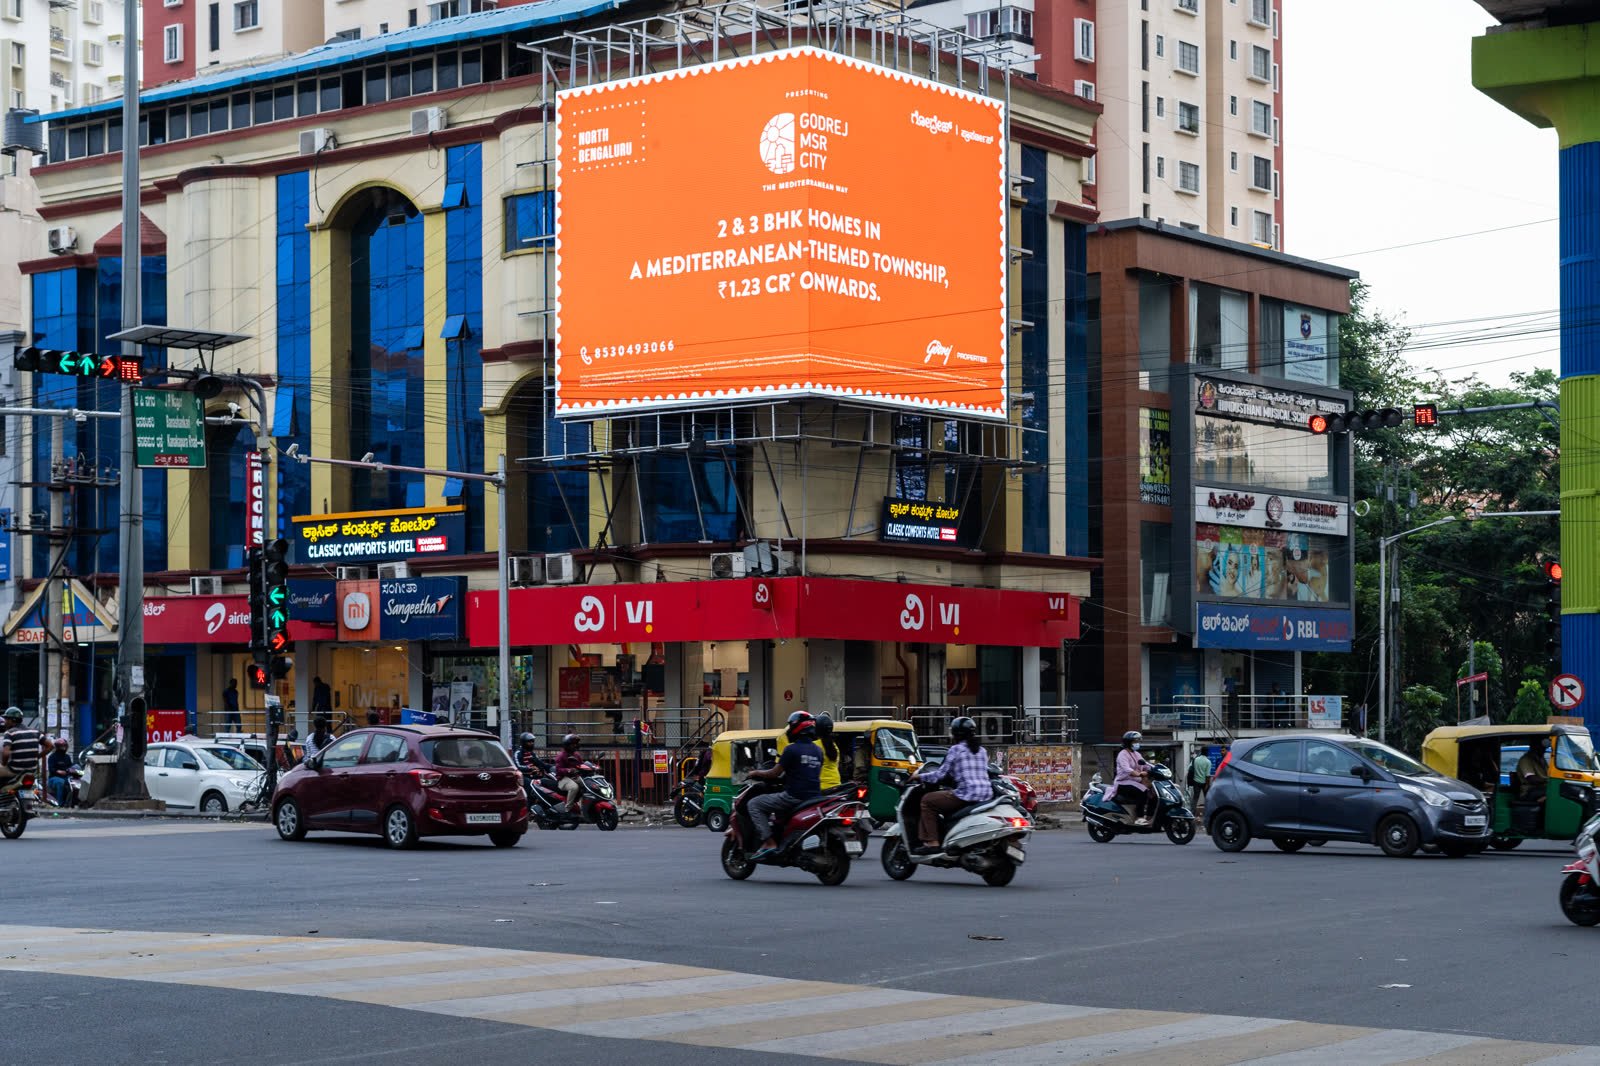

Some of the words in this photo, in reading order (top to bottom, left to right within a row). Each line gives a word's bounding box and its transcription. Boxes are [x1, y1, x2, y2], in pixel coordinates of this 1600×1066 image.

[785, 88, 828, 100] PRESENTING
[799, 112, 848, 137] GODREJ
[578, 128, 609, 146] NORTH
[800, 132, 828, 151] MSR
[578, 142, 632, 164] BENGALURU
[799, 152, 827, 170] CITY
[762, 184, 776, 192] THE
[778, 178, 834, 190] MEDITERRANEAN
[836, 185, 848, 194] WAY
[717, 220, 728, 238] 2
[732, 217, 746, 236] &
[749, 215, 759, 234] 3
[764, 208, 803, 232] BHK
[808, 208, 862, 237] HOMES
[864, 220, 881, 240] IN
[629, 260, 643, 280] A
[646, 239, 870, 278] MEDITERRANEAN-THEMED
[872, 252, 949, 290] TOWNSHIP,
[717, 276, 761, 299] ₹1.23
[799, 270, 881, 302] ONWARDS.
[594, 340, 675, 359] 8530493066
[956, 351, 988, 364] PROPERTIES
[1218, 400, 1262, 417] HINDUSTHAN
[1262, 406, 1292, 421] MUSICAL
[390, 516, 436, 533] ಹೋಟೆಲ್
[888, 522, 904, 536] CLASSIC
[904, 524, 927, 538] COMFORTS
[927, 526, 940, 540] HOTEL
[308, 544, 342, 558] CLASSIC
[343, 540, 387, 556] COMFORTS
[389, 539, 416, 554] HOTEL
[382, 582, 418, 595] ಸಂಗೀತಾ
[384, 595, 436, 624] Sangeetha
[574, 595, 605, 632] ವಿ
[900, 594, 924, 630] ವಿ
[1298, 620, 1320, 639] RBL
